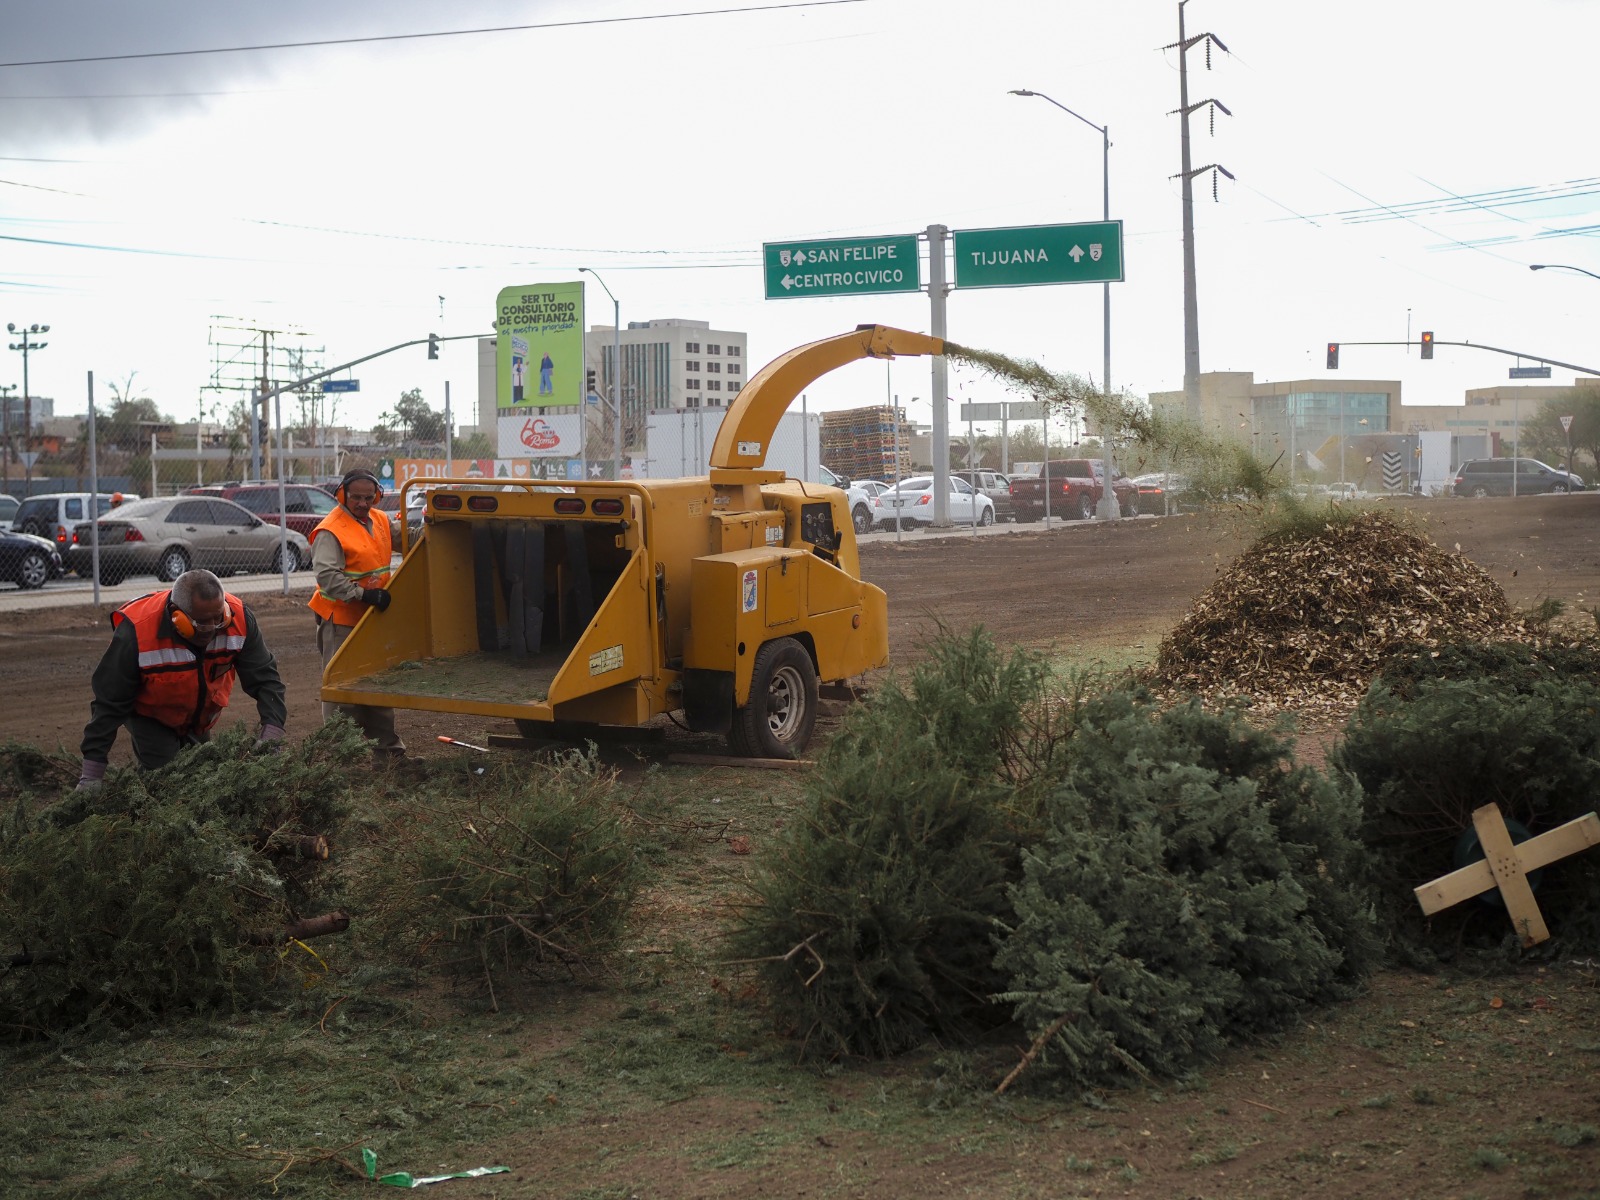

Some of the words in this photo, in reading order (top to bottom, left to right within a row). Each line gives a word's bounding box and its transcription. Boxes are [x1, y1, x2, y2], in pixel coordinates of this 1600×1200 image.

[808, 248, 839, 263] SAN
[843, 245, 897, 262] FELIPE
[971, 248, 1049, 266] TIJUANA
[1093, 250, 1099, 259] 2
[521, 295, 540, 304] SER
[542, 293, 555, 303] TU
[502, 302, 575, 315] CONSULTORIO
[499, 315, 512, 326] DE
[513, 312, 579, 325] CONFIANZA,
[530, 434, 555, 447] Roma
[402, 463, 418, 480] 12
[532, 463, 566, 476] VLLA
